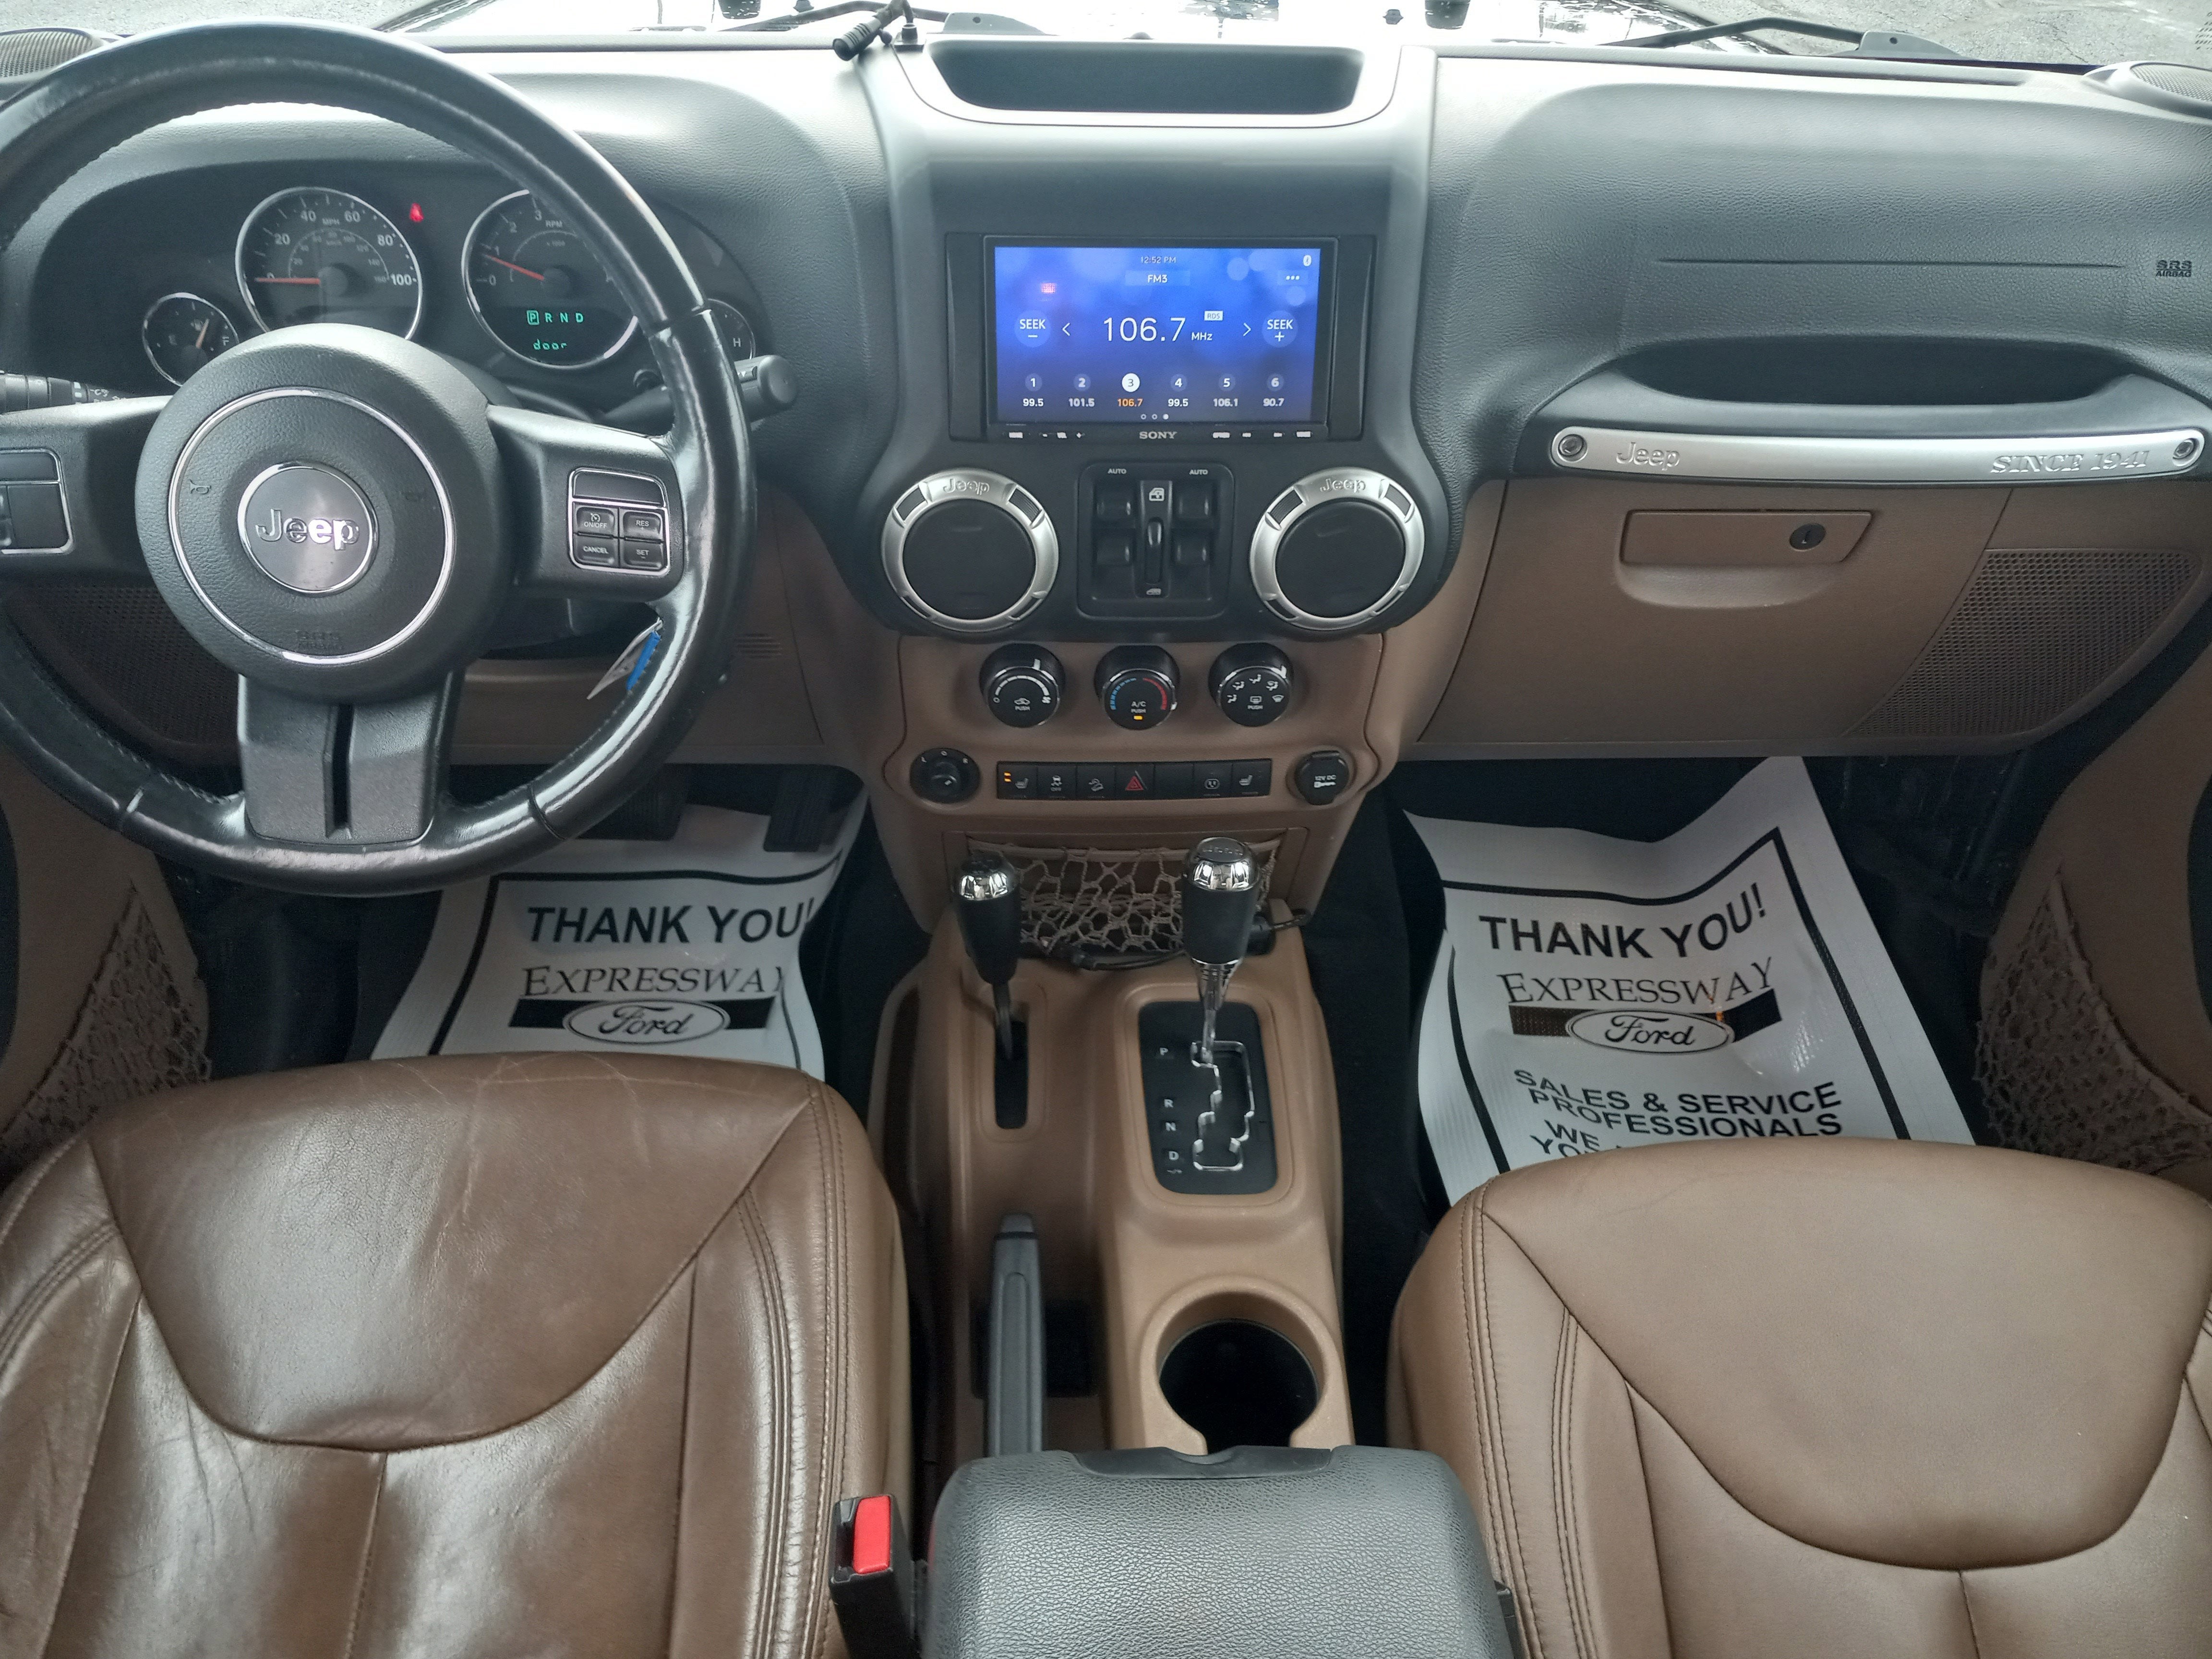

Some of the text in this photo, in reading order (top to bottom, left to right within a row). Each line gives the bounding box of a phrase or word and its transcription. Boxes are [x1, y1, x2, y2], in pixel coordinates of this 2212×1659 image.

[300, 210, 316, 222] 40
[344, 210, 360, 222] 60
[535, 209, 542, 221] 3
[509, 221, 517, 233] 2
[274, 233, 290, 245] 20
[377, 234, 393, 246] 80
[1140, 256, 1176, 264] 12:52 PM
[2156, 260, 2192, 270] SRS
[390, 273, 412, 286] 100
[489, 274, 496, 286] 0
[1147, 274, 1168, 283] FM3
[544, 312, 553, 323] R
[560, 312, 568, 323] N
[575, 313, 584, 323] D
[1206, 312, 1221, 320] RDS
[1019, 318, 1046, 330] SEEK
[1103, 317, 1213, 342] 106.7 MHz
[1267, 318, 1293, 330] SEEK
[533, 338, 567, 350] door
[733, 337, 741, 348] H
[1030, 377, 1036, 387] 1
[1078, 377, 1086, 387] 2
[1127, 377, 1134, 387] 3
[1175, 377, 1182, 387] 4
[1223, 377, 1230, 387] 5
[1271, 377, 1279, 387] 6
[1022, 398, 1044, 407] 99.5
[1068, 398, 1095, 407] 101.5
[1117, 398, 1143, 407] 106.7
[1167, 398, 1189, 407] 99.5
[1213, 398, 1238, 407] 106.1
[1263, 398, 1285, 407] 90.7
[1139, 431, 1177, 439] SONY
[1616, 442, 1680, 471] Jeep
[1990, 450, 2150, 473] SINCE 1941
[942, 478, 990, 496] Jeep
[1320, 478, 1366, 493] Jeep
[254, 508, 360, 551] Jeep
[583, 545, 609, 554] CANCEL
[527, 905, 691, 944] THANK
[1479, 881, 1767, 959] THANK YOU!
[1496, 955, 1772, 1005] EXPRESSWAY
[598, 1005, 695, 1036] Ford
[1604, 1013, 1695, 1047] Ford
[1160, 1047, 1168, 1056] P
[1514, 1069, 1842, 1116] SALES & SERVICE
[1164, 1098, 1173, 1108] R
[1530, 1088, 1843, 1137] PROFESSIONALS
[1165, 1121, 1176, 1131] N
[1544, 1119, 1600, 1153] WE
[1168, 1151, 1179, 1160] D
